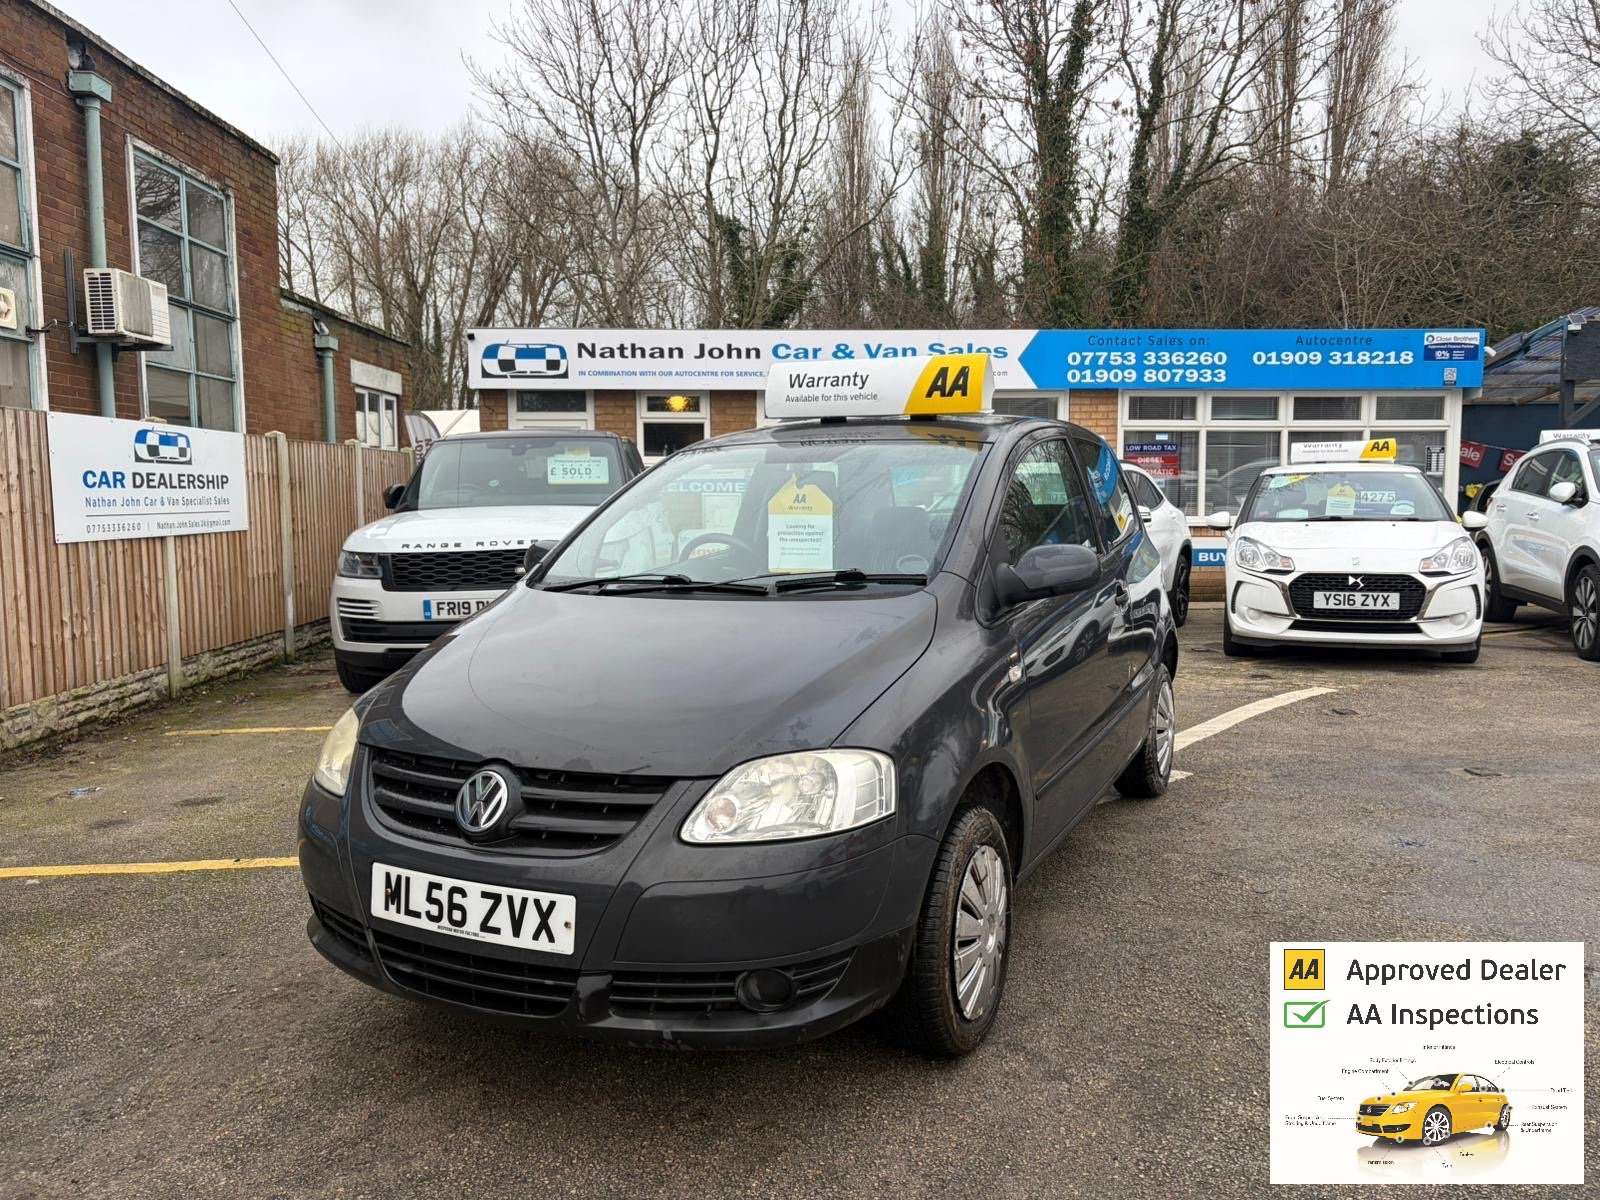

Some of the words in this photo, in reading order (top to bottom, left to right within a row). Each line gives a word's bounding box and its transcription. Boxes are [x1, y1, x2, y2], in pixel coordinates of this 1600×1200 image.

[1088, 336, 1142, 346] Contact
[1148, 336, 1184, 346] Sales
[1186, 336, 1210, 346] on:
[1296, 336, 1374, 346] Autocentre
[577, 342, 684, 359] Nathan
[694, 343, 761, 359] John
[772, 343, 822, 360] Car
[832, 343, 855, 360] &
[863, 343, 917, 358] Van
[928, 342, 1008, 358] Sales
[1067, 352, 1136, 366] 07753
[1143, 352, 1227, 366] 336260
[1252, 351, 1322, 365] 01909
[1328, 351, 1414, 365] 318218
[789, 372, 870, 390] Warranty
[1066, 368, 1136, 383] 01909
[1143, 368, 1227, 383] 807933
[925, 366, 970, 398] AA
[785, 394, 820, 402] Available
[822, 394, 832, 402] for
[834, 394, 848, 402] this
[850, 392, 878, 400] vehicle
[1370, 441, 1390, 452] AA
[1460, 447, 1480, 461] ale
[562, 467, 592, 476] SOLD
[82, 470, 126, 488] CAR
[132, 472, 230, 490] DEALERSHIP
[667, 482, 745, 492] ELCOME
[85, 496, 117, 508] Nathan
[120, 496, 141, 508] John
[144, 496, 157, 507] Car
[160, 496, 166, 506] &
[167, 496, 180, 506] Van
[181, 496, 212, 507] Specialist
[214, 496, 230, 506] Sales
[793, 493, 807, 504] AA
[1361, 492, 1395, 502] 4275
[86, 522, 142, 534] 07753336260
[1198, 552, 1226, 562] BUY
[1323, 594, 1356, 606] YS16
[1358, 594, 1390, 607] ZYX
[436, 601, 471, 616] FR19
[384, 871, 468, 929] ML56
[479, 890, 557, 944] ZVX
